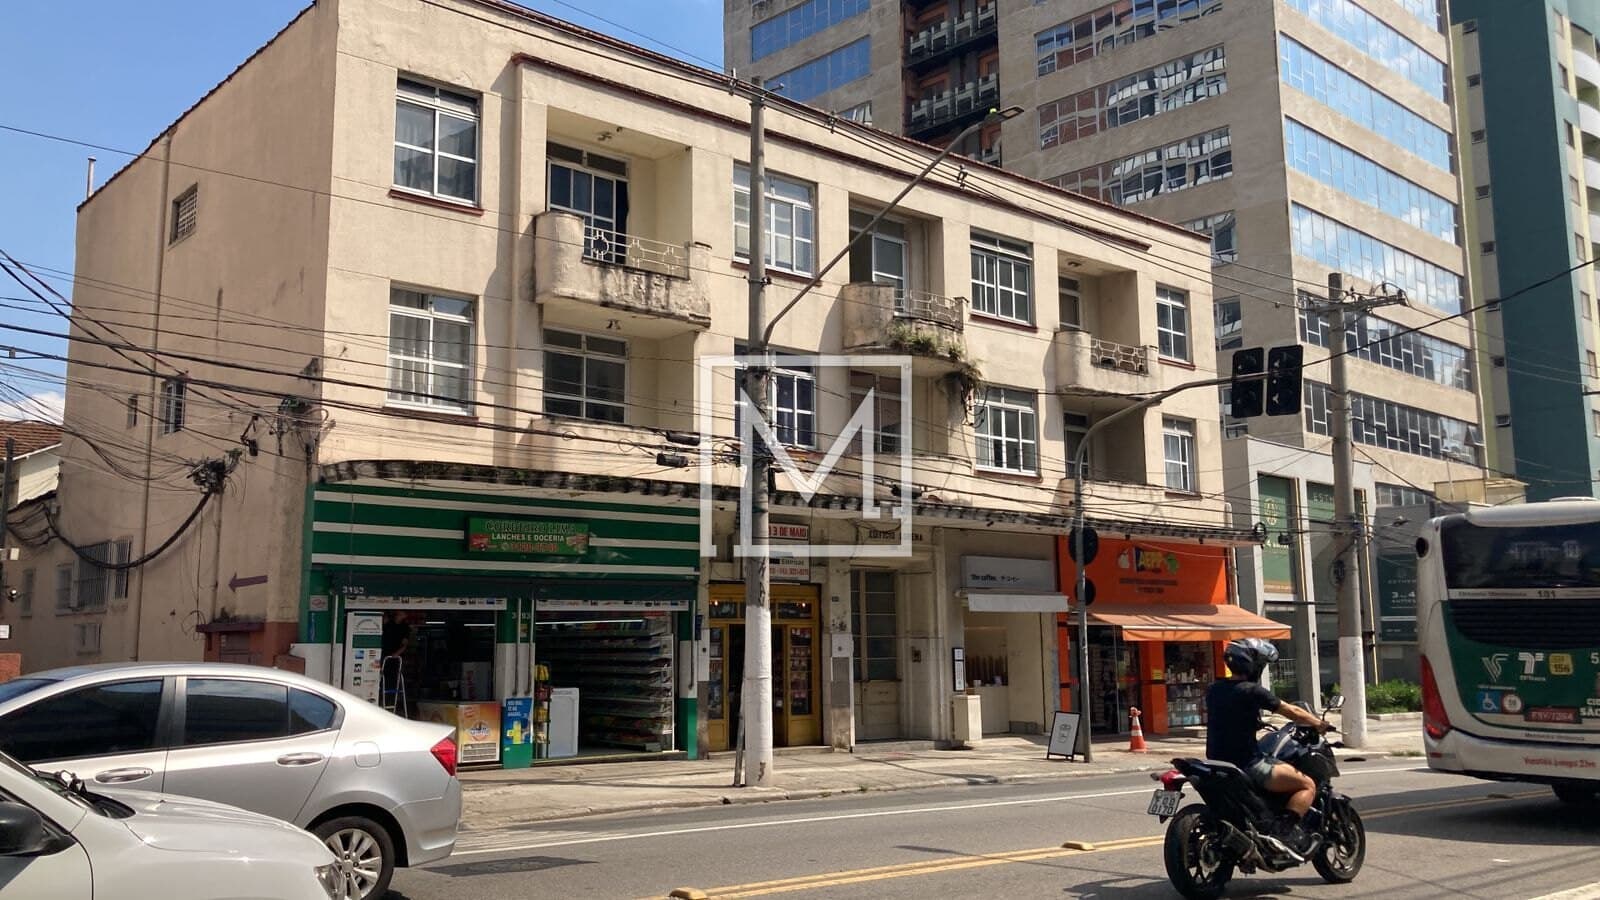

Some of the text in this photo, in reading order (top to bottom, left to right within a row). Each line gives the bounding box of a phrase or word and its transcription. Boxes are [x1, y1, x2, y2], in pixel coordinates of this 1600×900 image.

[790, 527, 807, 537] MAIO
[492, 533, 525, 541] LANCHES
[534, 534, 565, 542] DOCERIA
[511, 611, 531, 620] 393
